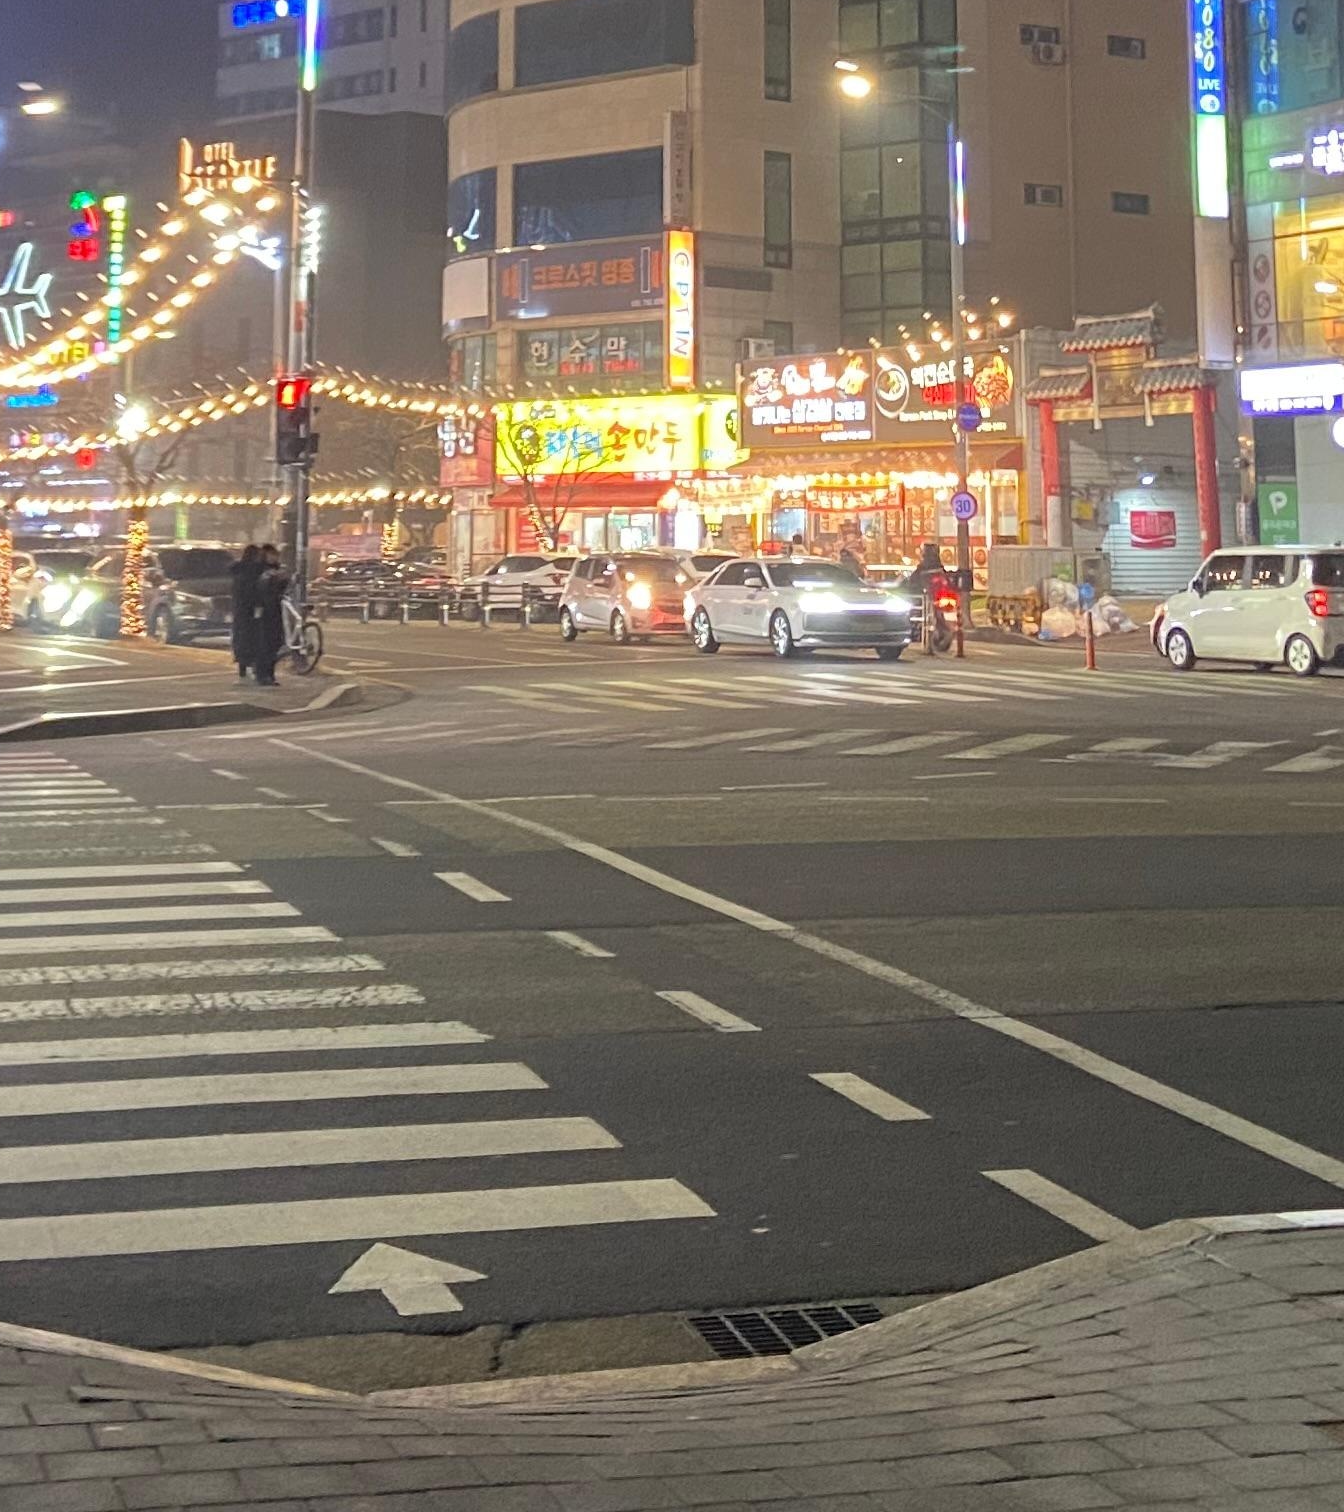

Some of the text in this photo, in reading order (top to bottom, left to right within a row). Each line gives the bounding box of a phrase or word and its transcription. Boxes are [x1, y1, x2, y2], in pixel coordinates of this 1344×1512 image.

[1197, 78, 1221, 91] LIVE
[531, 257, 636, 291] 크로스핏 영종
[529, 336, 628, 367] 현수막
[607, 420, 682, 463] 손만두
[955, 500, 971, 513] 30
